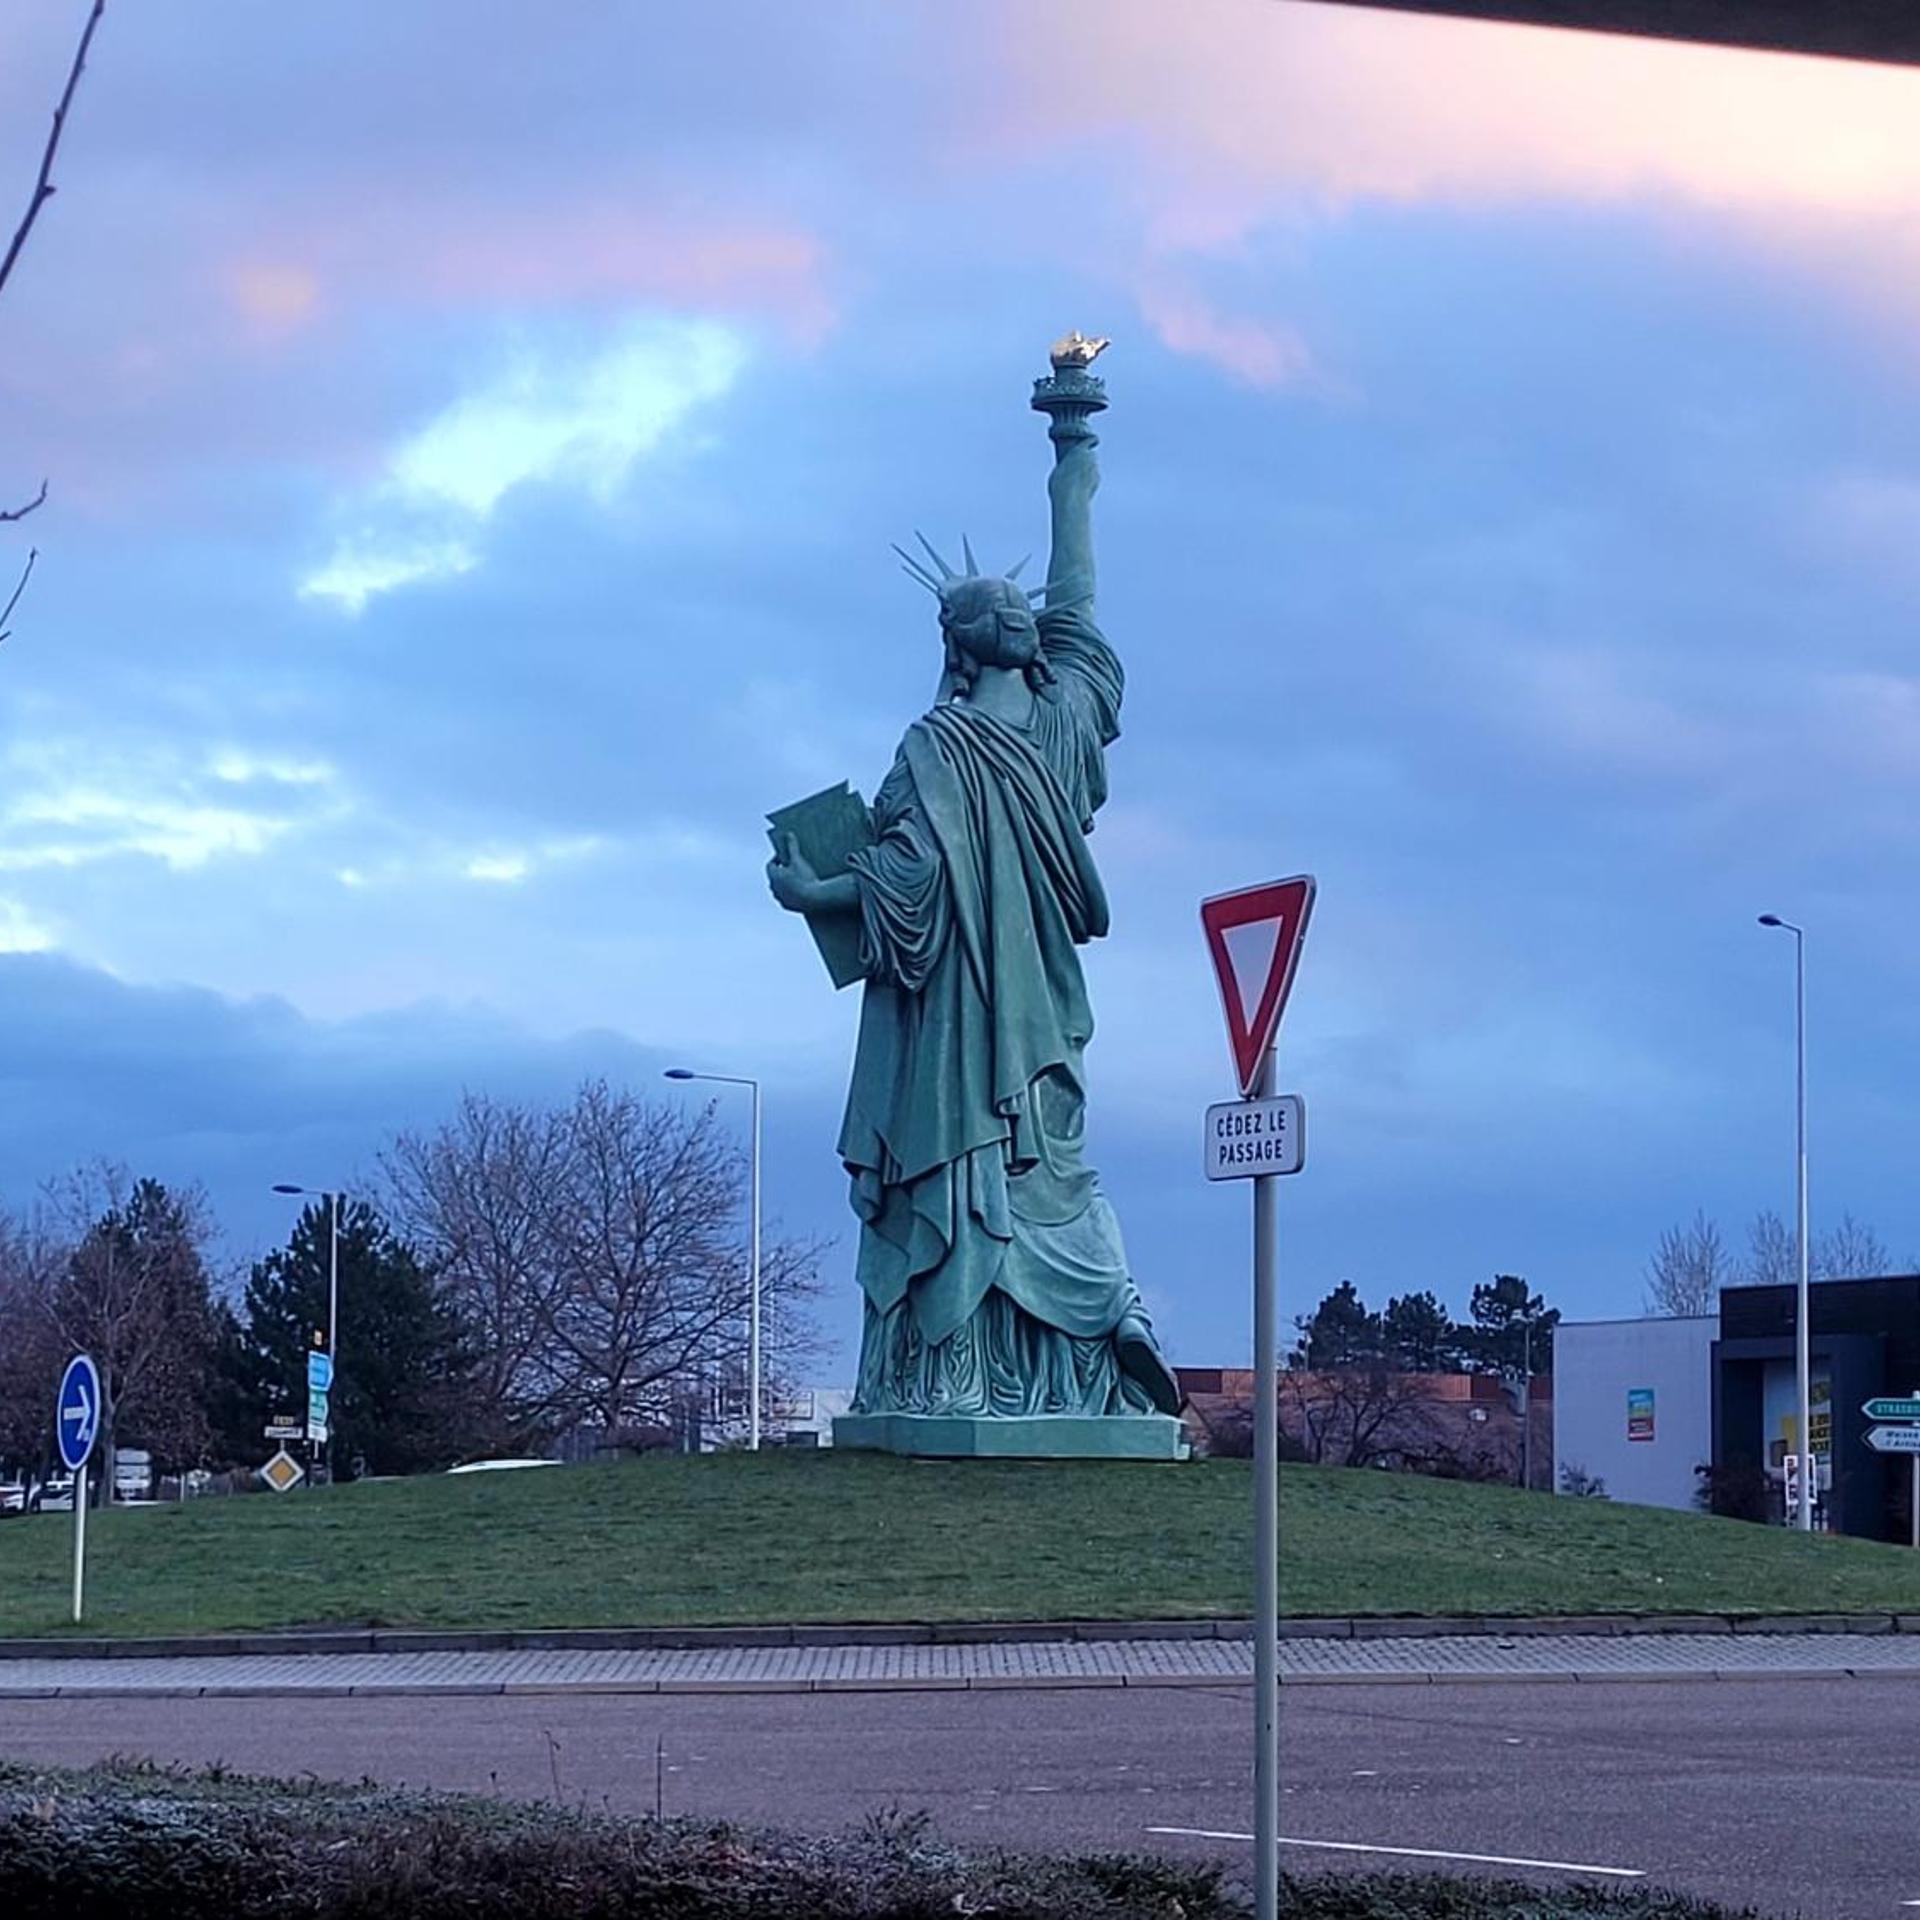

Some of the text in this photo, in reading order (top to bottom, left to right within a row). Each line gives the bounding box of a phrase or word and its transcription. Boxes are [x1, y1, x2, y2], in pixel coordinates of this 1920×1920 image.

[1217, 1110, 1286, 1138] CÉDEZ LE
[1219, 1138, 1282, 1166] PASSAGE
